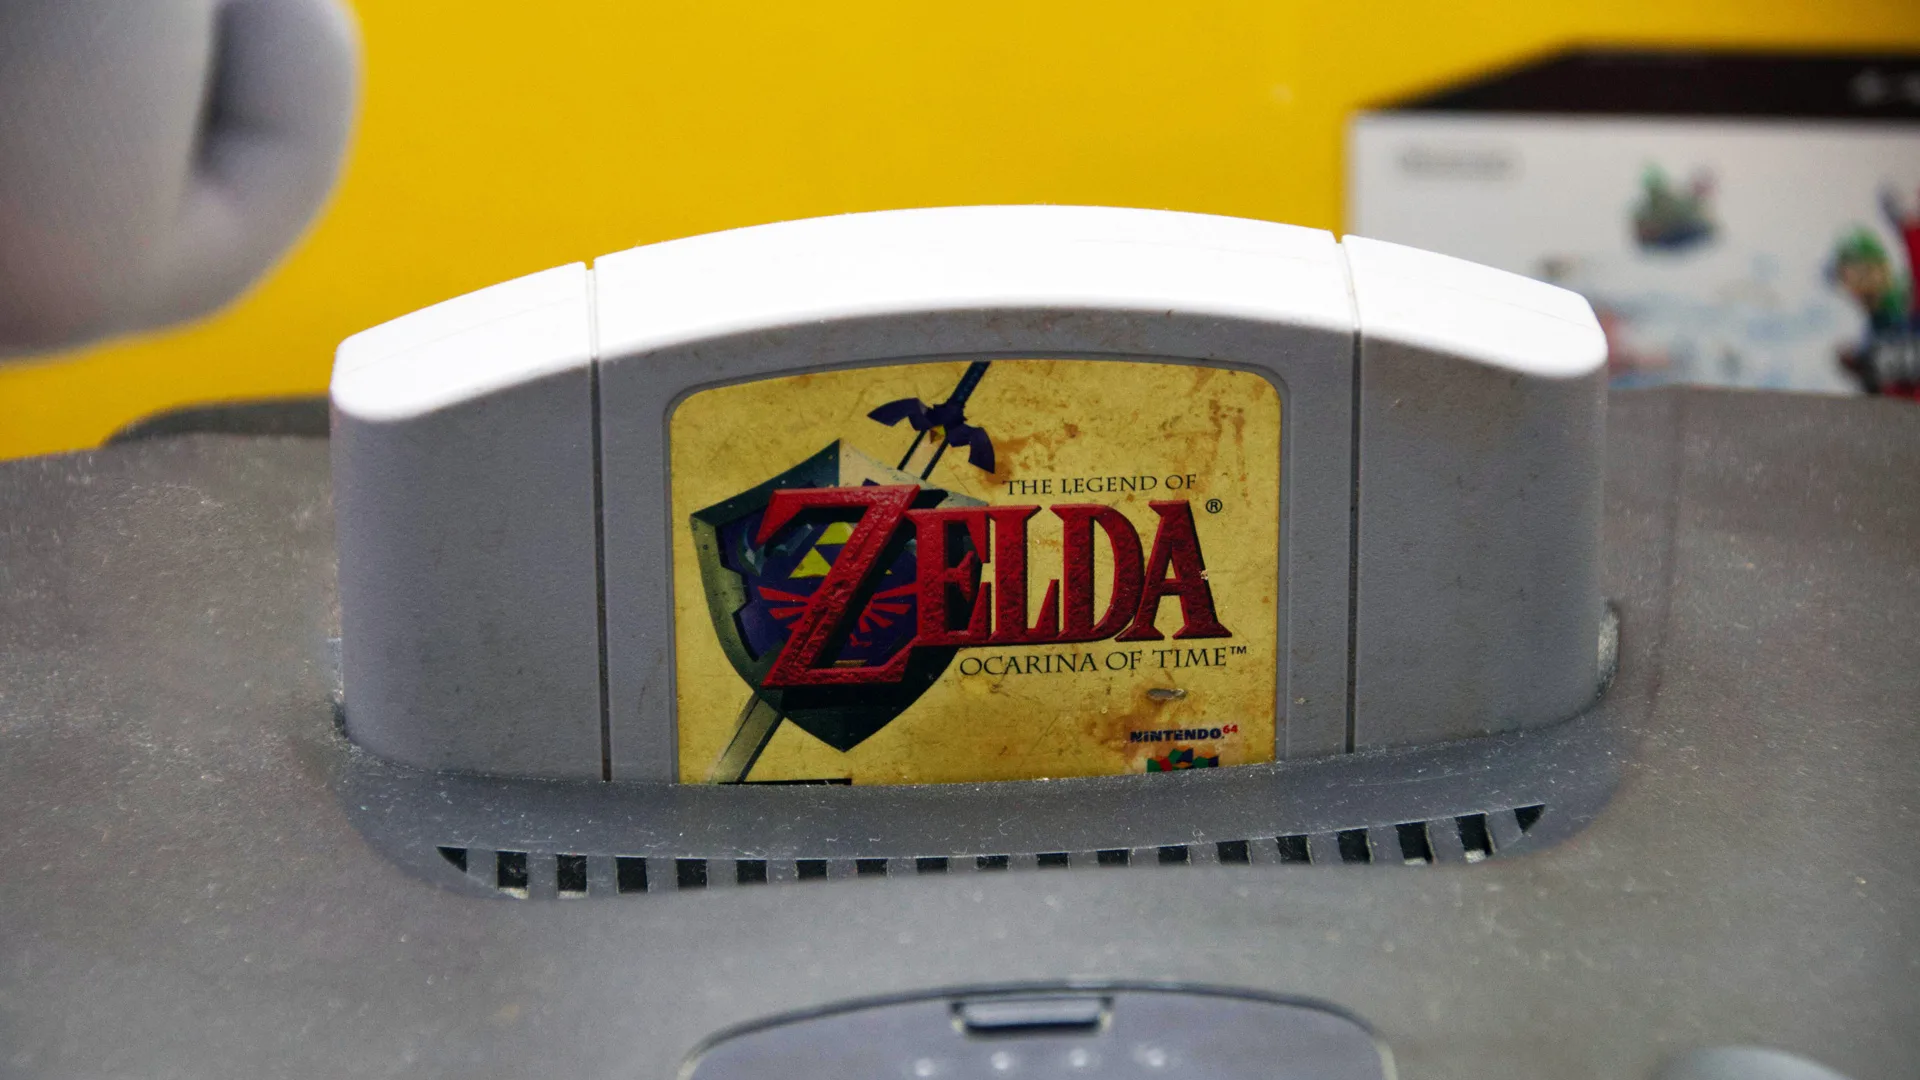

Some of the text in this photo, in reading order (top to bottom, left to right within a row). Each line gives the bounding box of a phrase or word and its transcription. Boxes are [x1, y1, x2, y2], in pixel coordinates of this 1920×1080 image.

[1004, 473, 1197, 496] THE LEGEND OF
[959, 652, 1097, 676] OCARINA
[1105, 650, 1143, 672] OF
